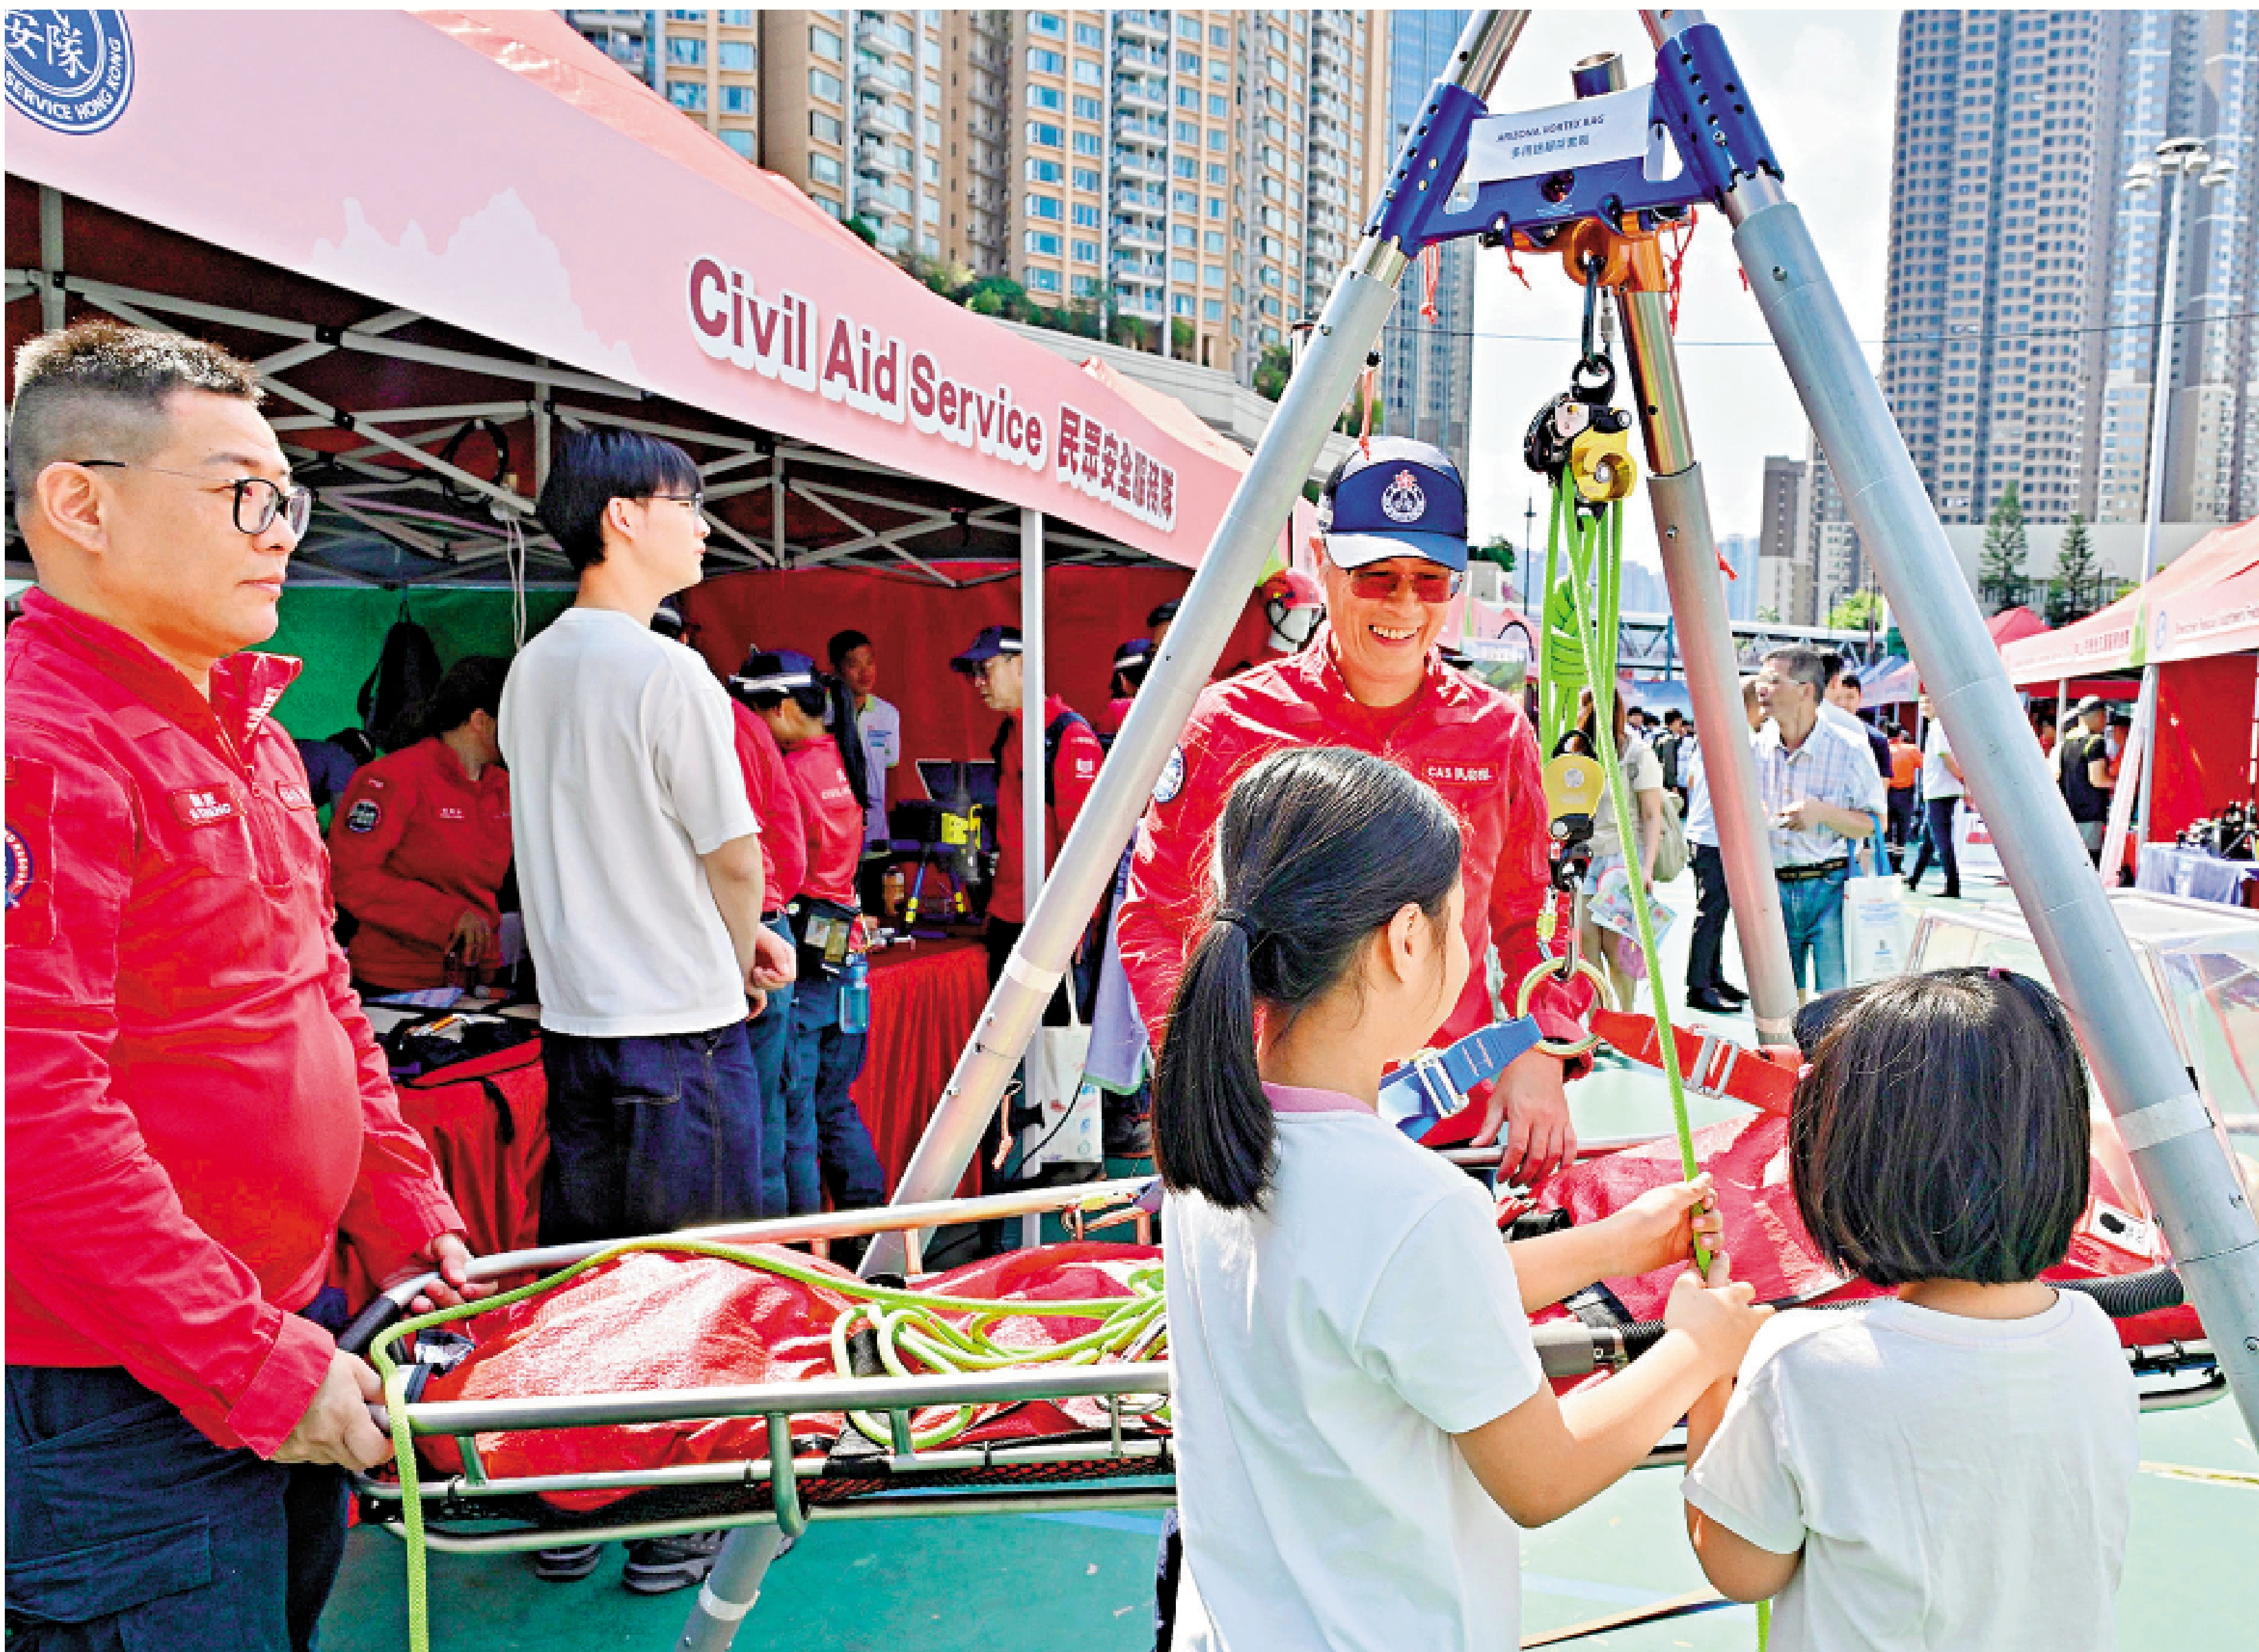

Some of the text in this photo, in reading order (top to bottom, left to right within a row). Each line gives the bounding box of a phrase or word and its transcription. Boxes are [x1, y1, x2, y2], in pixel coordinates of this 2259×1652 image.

[74, 87, 114, 121] HONG
[106, 36, 122, 91] KONG
[690, 258, 1041, 456] Civil Aid Service
[1428, 767, 1452, 778] CAS
